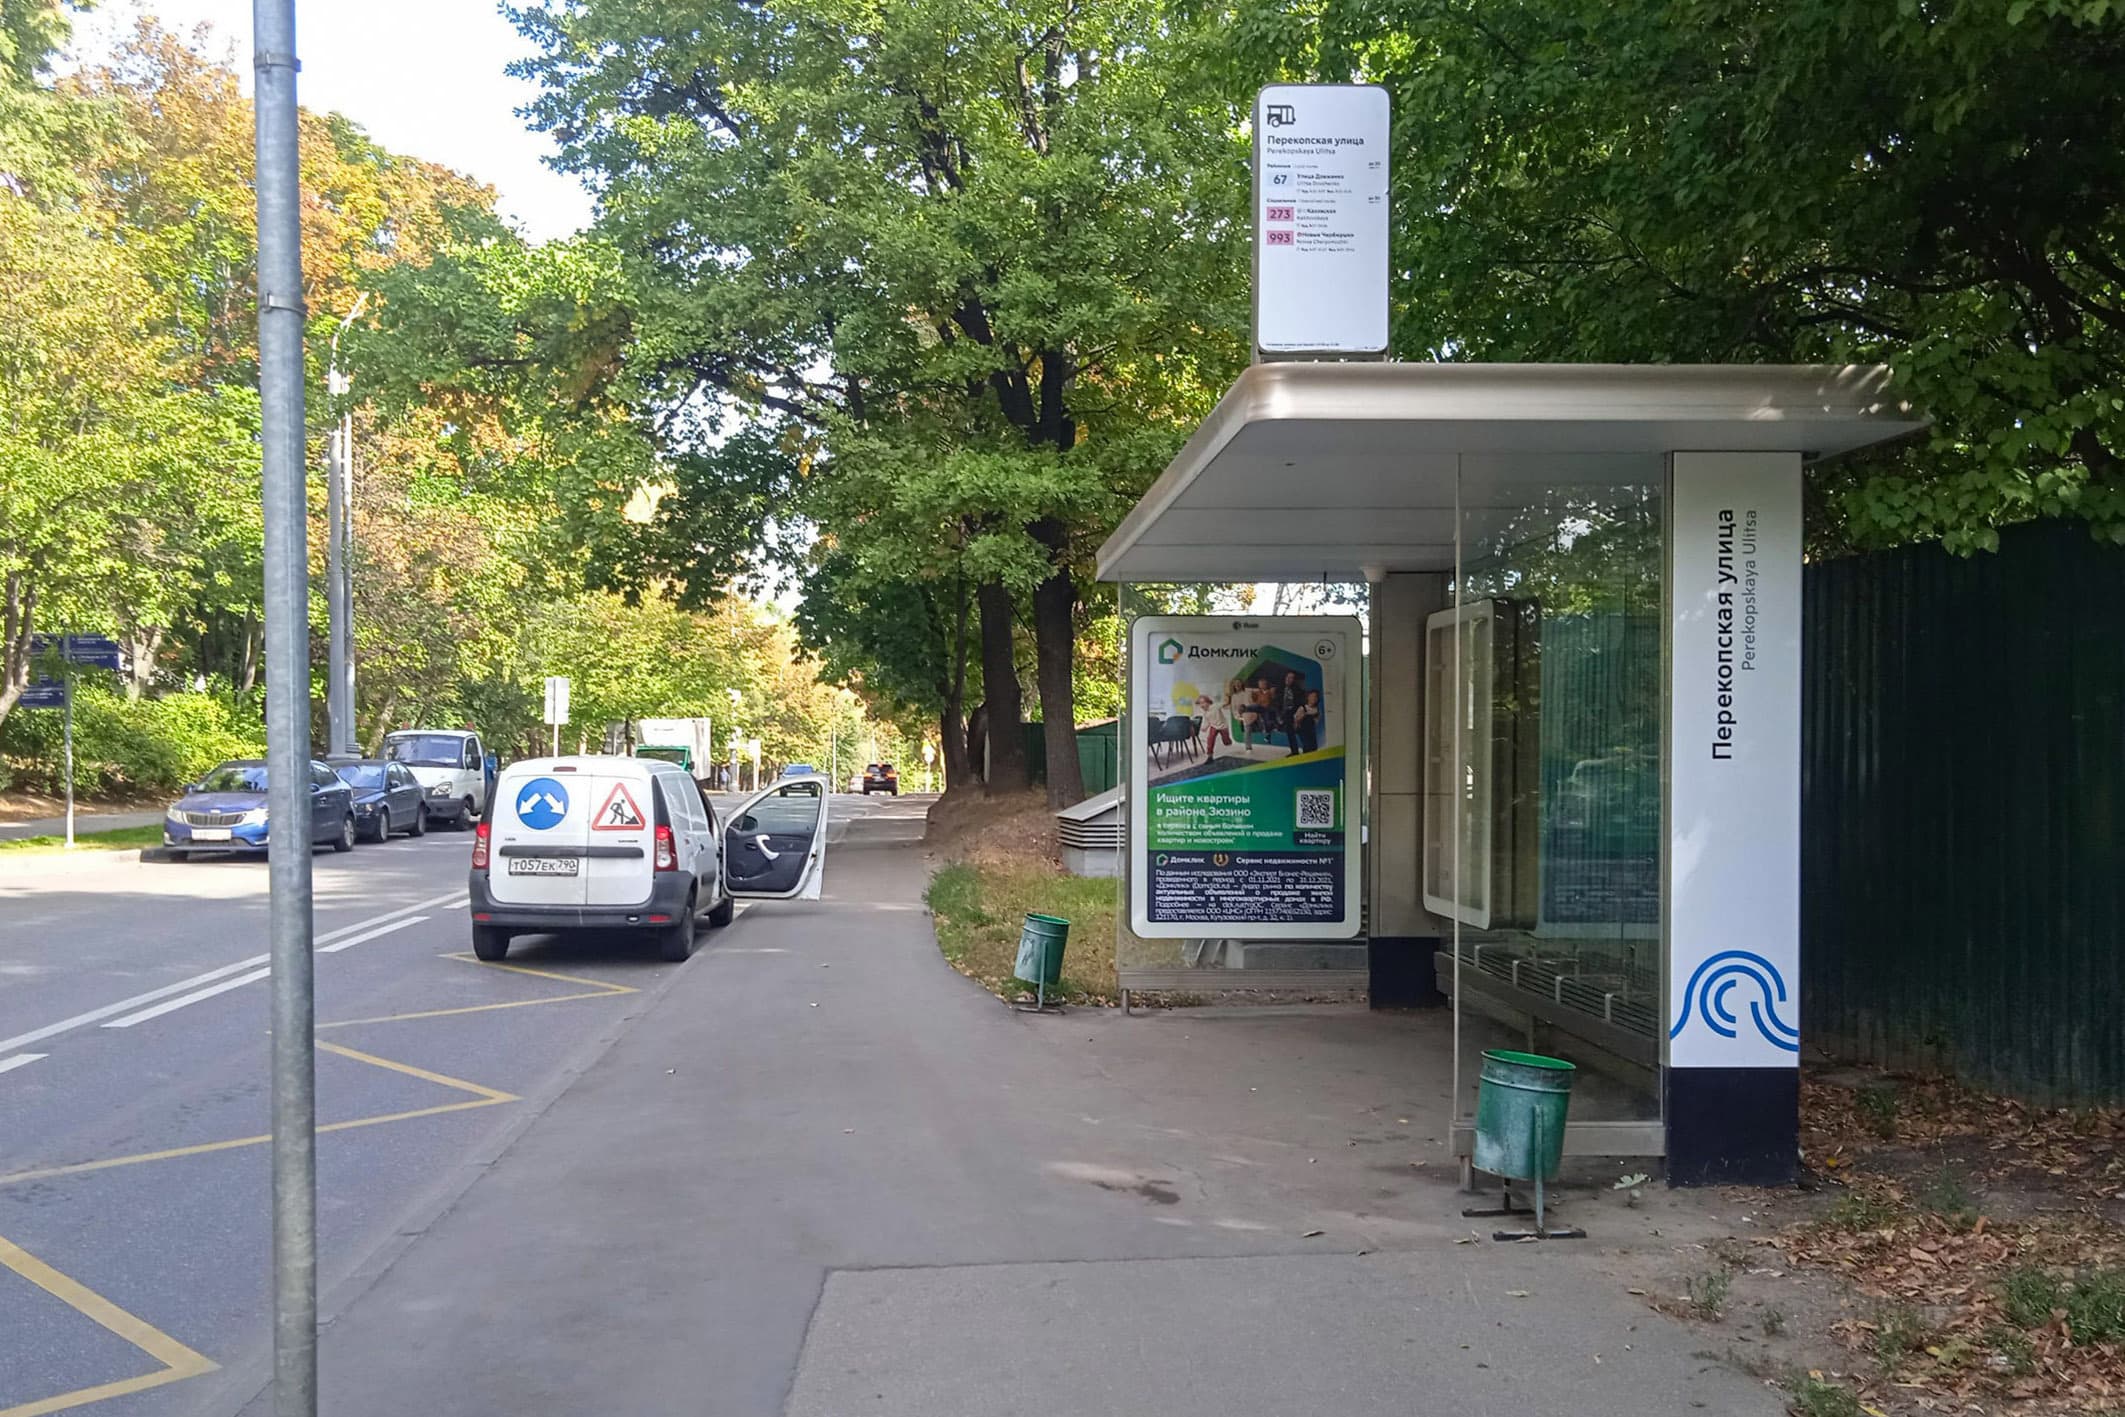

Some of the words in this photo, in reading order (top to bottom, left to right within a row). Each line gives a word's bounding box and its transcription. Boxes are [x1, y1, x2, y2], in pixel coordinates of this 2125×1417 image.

[1267, 136, 1332, 146] Перекопская
[1334, 137, 1364, 146] улица
[1273, 175, 1287, 185] 67
[1270, 209, 1291, 219] 273
[1269, 233, 1291, 243] 993
[1742, 510, 1757, 554] Ulitsa
[1718, 509, 1738, 584] улица
[1741, 560, 1758, 671] Perekopskaya
[1188, 646, 1260, 659] Домклик
[1318, 645, 1332, 655] 6+
[1712, 592, 1737, 760] Перекопская
[1156, 793, 1194, 804] Ищите
[1196, 795, 1250, 805] квартиры
[1156, 808, 1163, 816] в
[1166, 806, 1206, 817] районе
[1209, 806, 1251, 816] Зюзино
